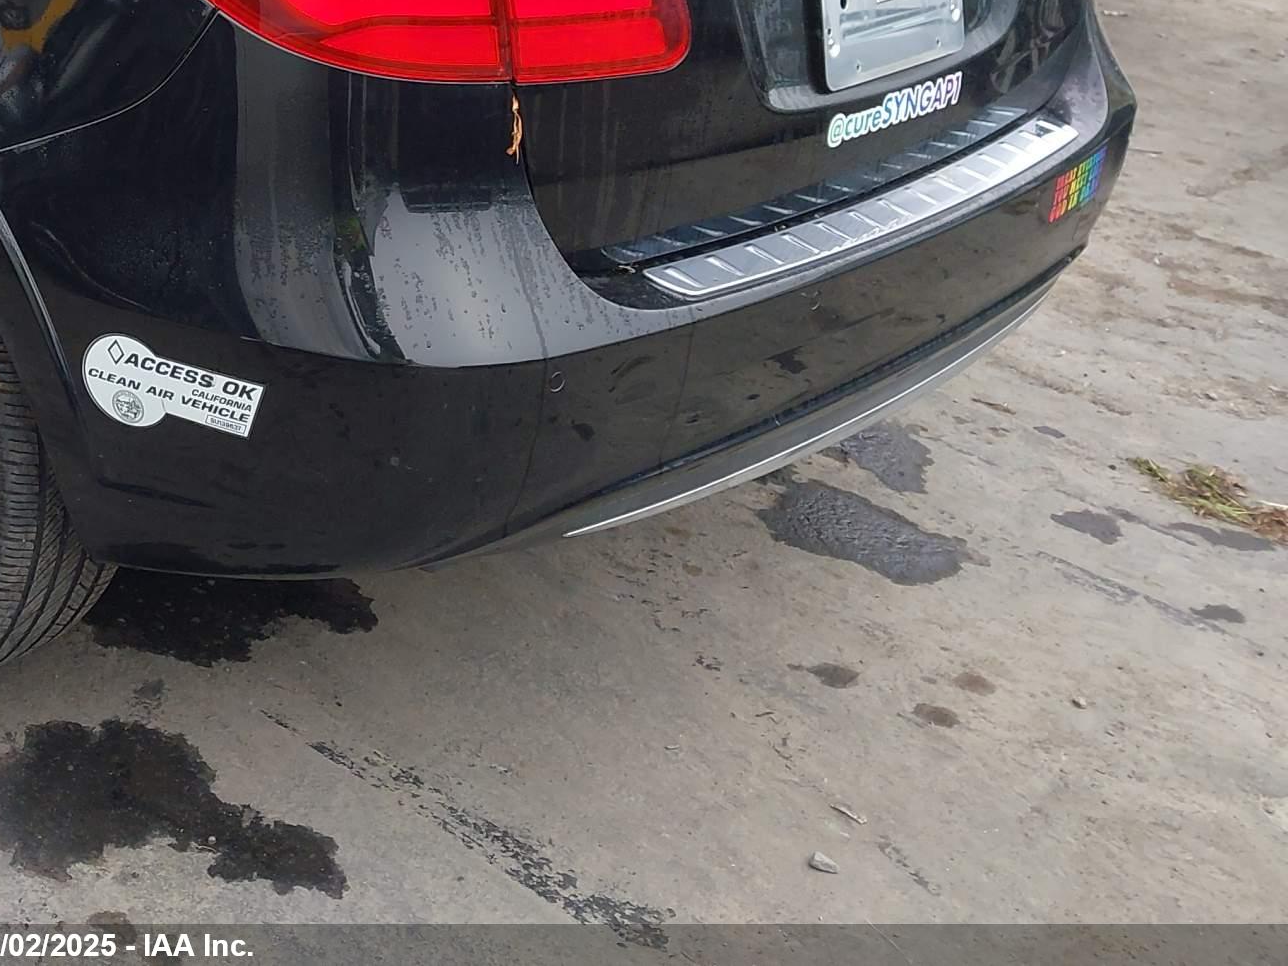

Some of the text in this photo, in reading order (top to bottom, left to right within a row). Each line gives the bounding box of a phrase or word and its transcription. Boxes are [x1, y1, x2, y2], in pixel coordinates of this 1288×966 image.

[88, 368, 250, 423] CLEAN AIR VEHICLE
[124, 353, 257, 400] ACCESS OK
[191, 389, 252, 412] CALIFORNIA
